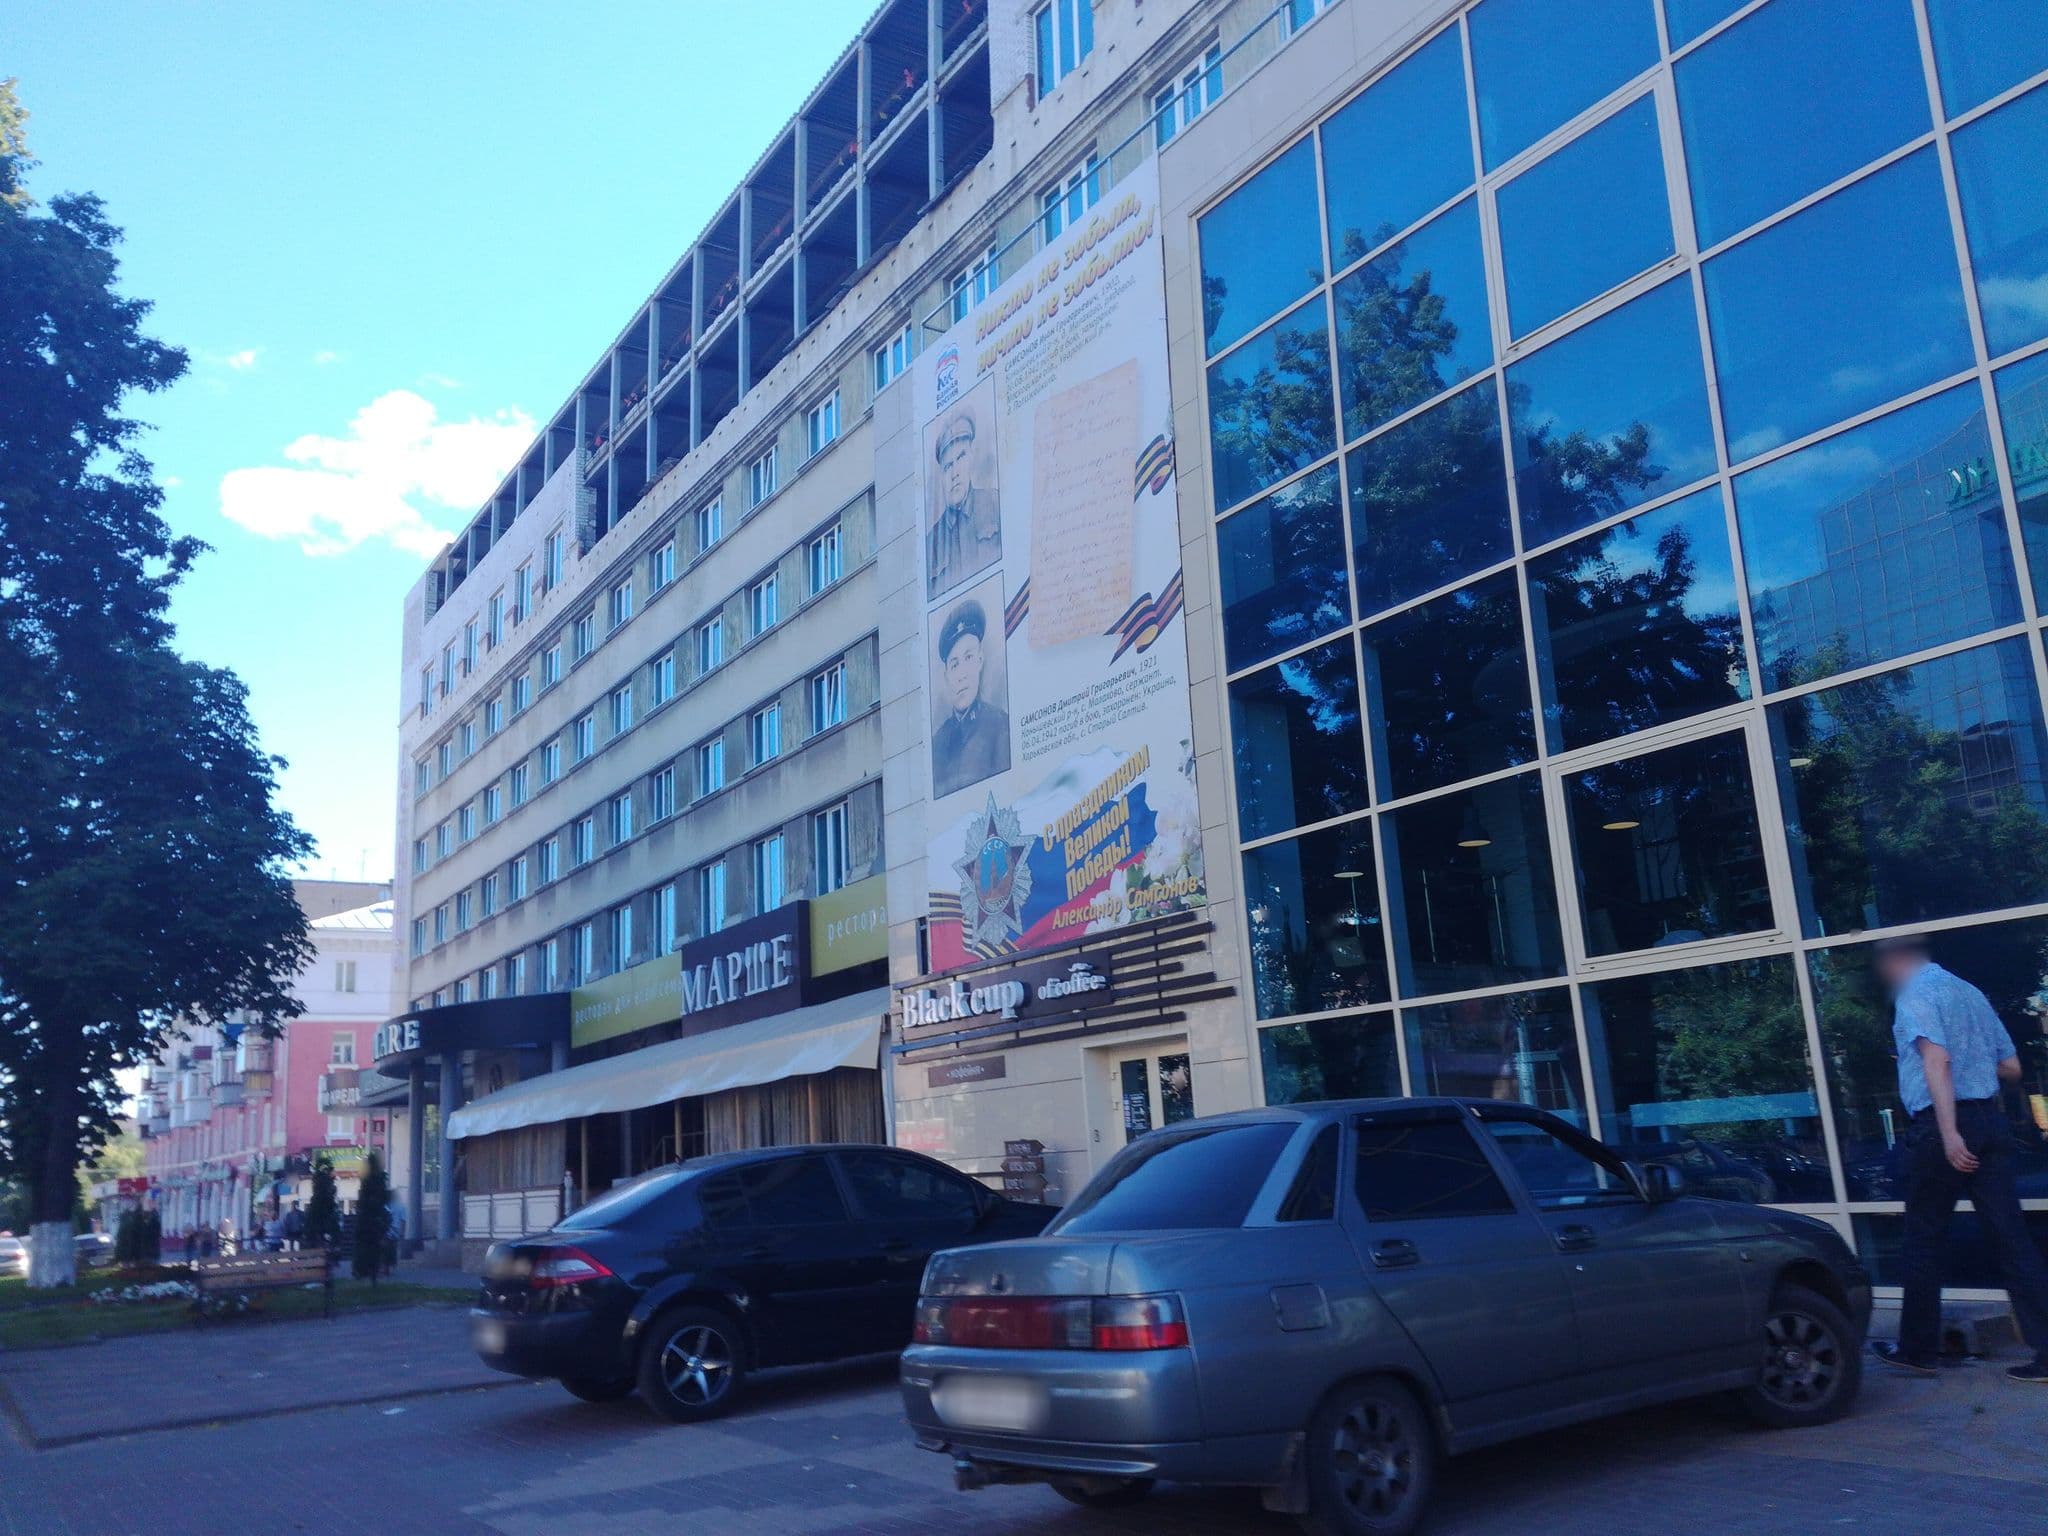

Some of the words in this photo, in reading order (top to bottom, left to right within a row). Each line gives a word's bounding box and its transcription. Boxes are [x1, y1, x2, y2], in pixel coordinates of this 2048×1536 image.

[976, 279, 1034, 346] Никто
[1037, 256, 1060, 294] не
[1037, 292, 1060, 329] не
[1020, 702, 1056, 727] САМСОНОВ
[1057, 686, 1089, 711] Дмитрий
[1090, 668, 1137, 695] Григорьевич,
[1043, 822, 1054, 852] С
[1055, 744, 1151, 843] праздником!
[1064, 793, 1130, 868] Великой
[1066, 824, 1132, 901] Победы!
[1052, 894, 1122, 930] Александр
[1125, 876, 1199, 911] Самсонов
[680, 933, 793, 1016] МАРШЕ
[902, 980, 972, 1029] Black
[970, 980, 1025, 1019] cup
